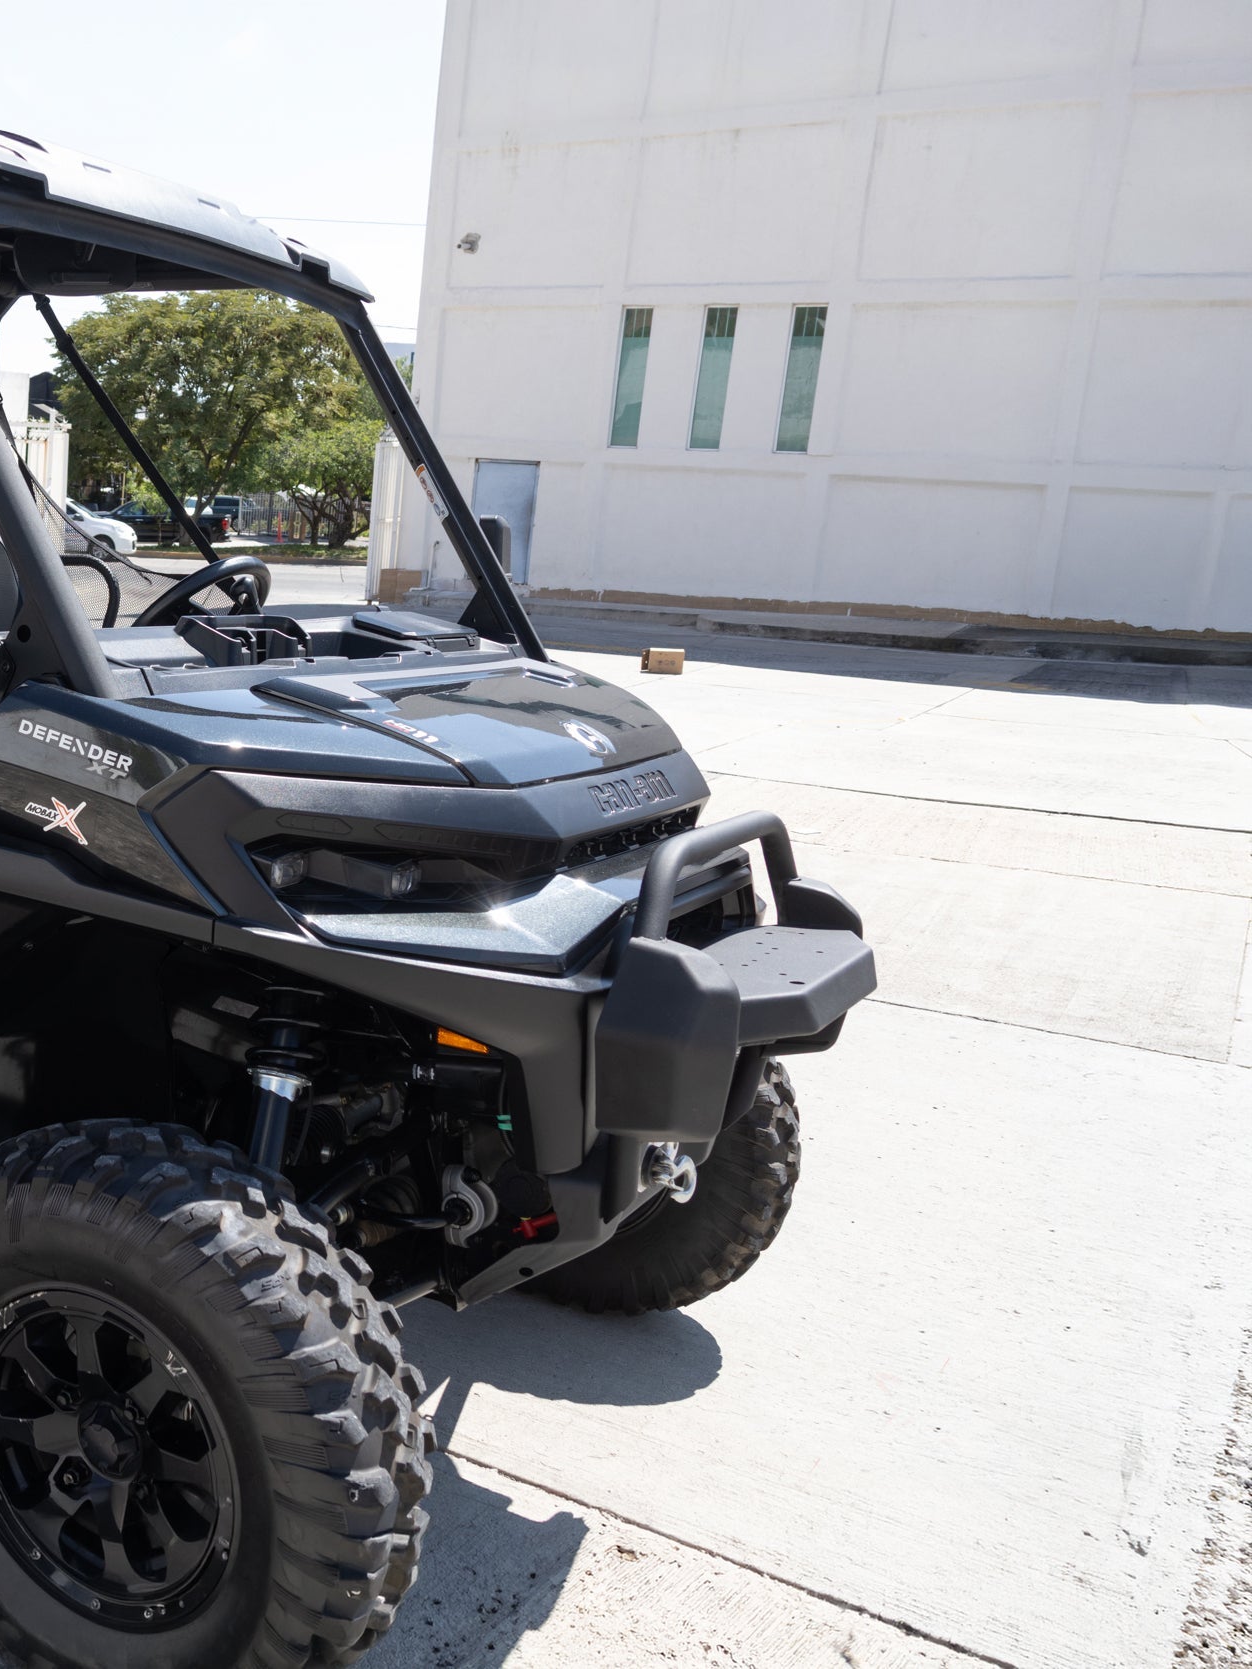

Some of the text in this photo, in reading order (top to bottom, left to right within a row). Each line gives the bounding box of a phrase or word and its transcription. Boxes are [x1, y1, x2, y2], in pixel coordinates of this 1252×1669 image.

[18, 719, 133, 772] DEFENDER
[85, 760, 128, 780] XT
[26, 804, 60, 820] MOBAX
